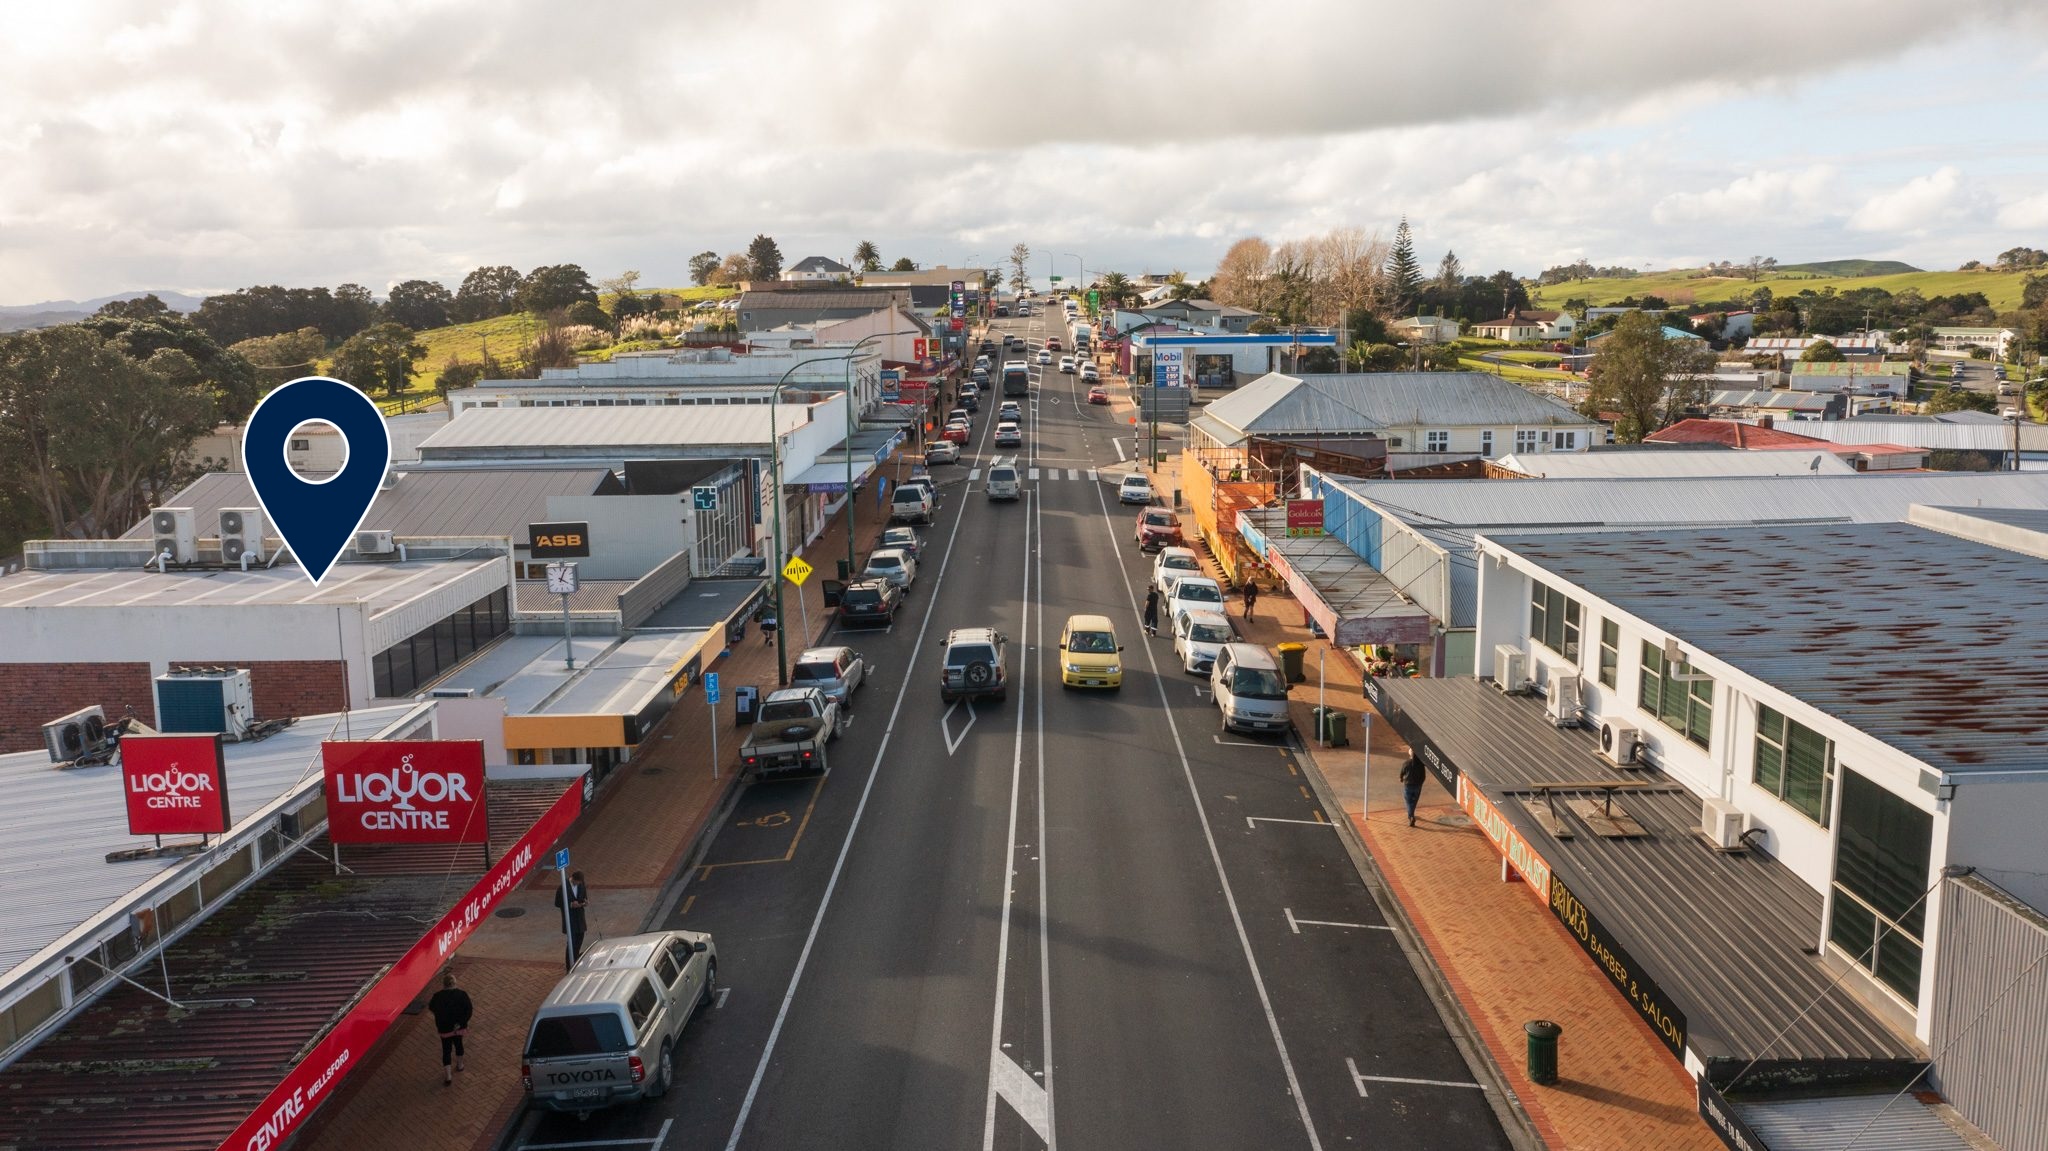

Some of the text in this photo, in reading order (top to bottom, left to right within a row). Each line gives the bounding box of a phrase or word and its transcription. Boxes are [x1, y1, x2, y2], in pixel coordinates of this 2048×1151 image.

[1155, 352, 1182, 361] Mobil
[536, 534, 582, 547] ASB
[130, 770, 214, 796] LIQUOR
[336, 768, 473, 811] LIQUOR
[147, 796, 201, 809] CENTRE
[361, 811, 450, 830] CENTRE
[1473, 791, 1549, 897] READY ROAST
[438, 844, 532, 956] We're BIG on being LOCAL
[1590, 934, 1628, 987] BARBER
[1630, 981, 1640, 1001] &
[1642, 993, 1683, 1049] SALON
[546, 1068, 616, 1085] TOYOTA
[246, 1049, 350, 1151] CENTRE WELLSFORD
